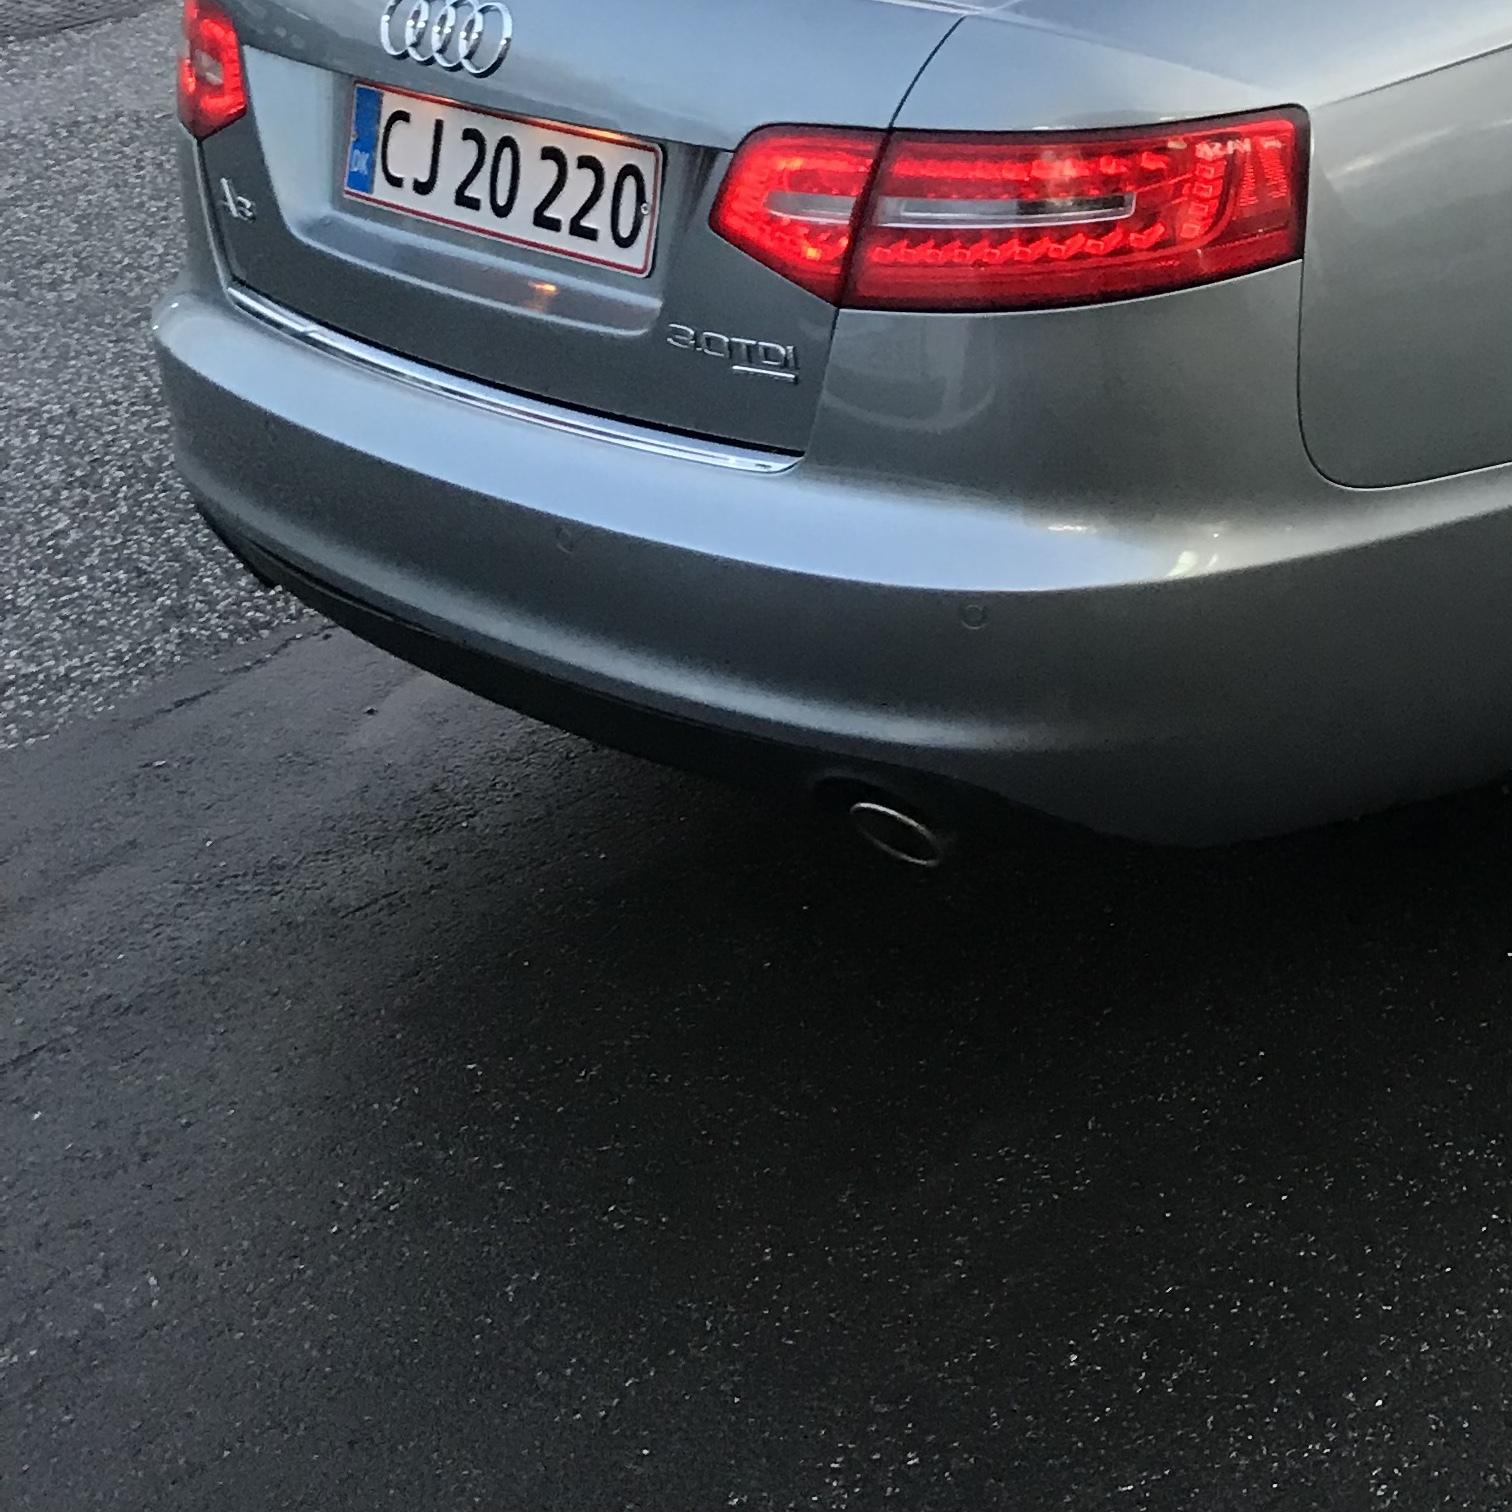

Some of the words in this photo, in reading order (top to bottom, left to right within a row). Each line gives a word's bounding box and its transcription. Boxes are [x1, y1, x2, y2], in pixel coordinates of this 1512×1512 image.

[350, 149, 370, 175] DK
[381, 109, 444, 196] CJ
[454, 127, 520, 219] 20
[533, 145, 647, 249] 220
